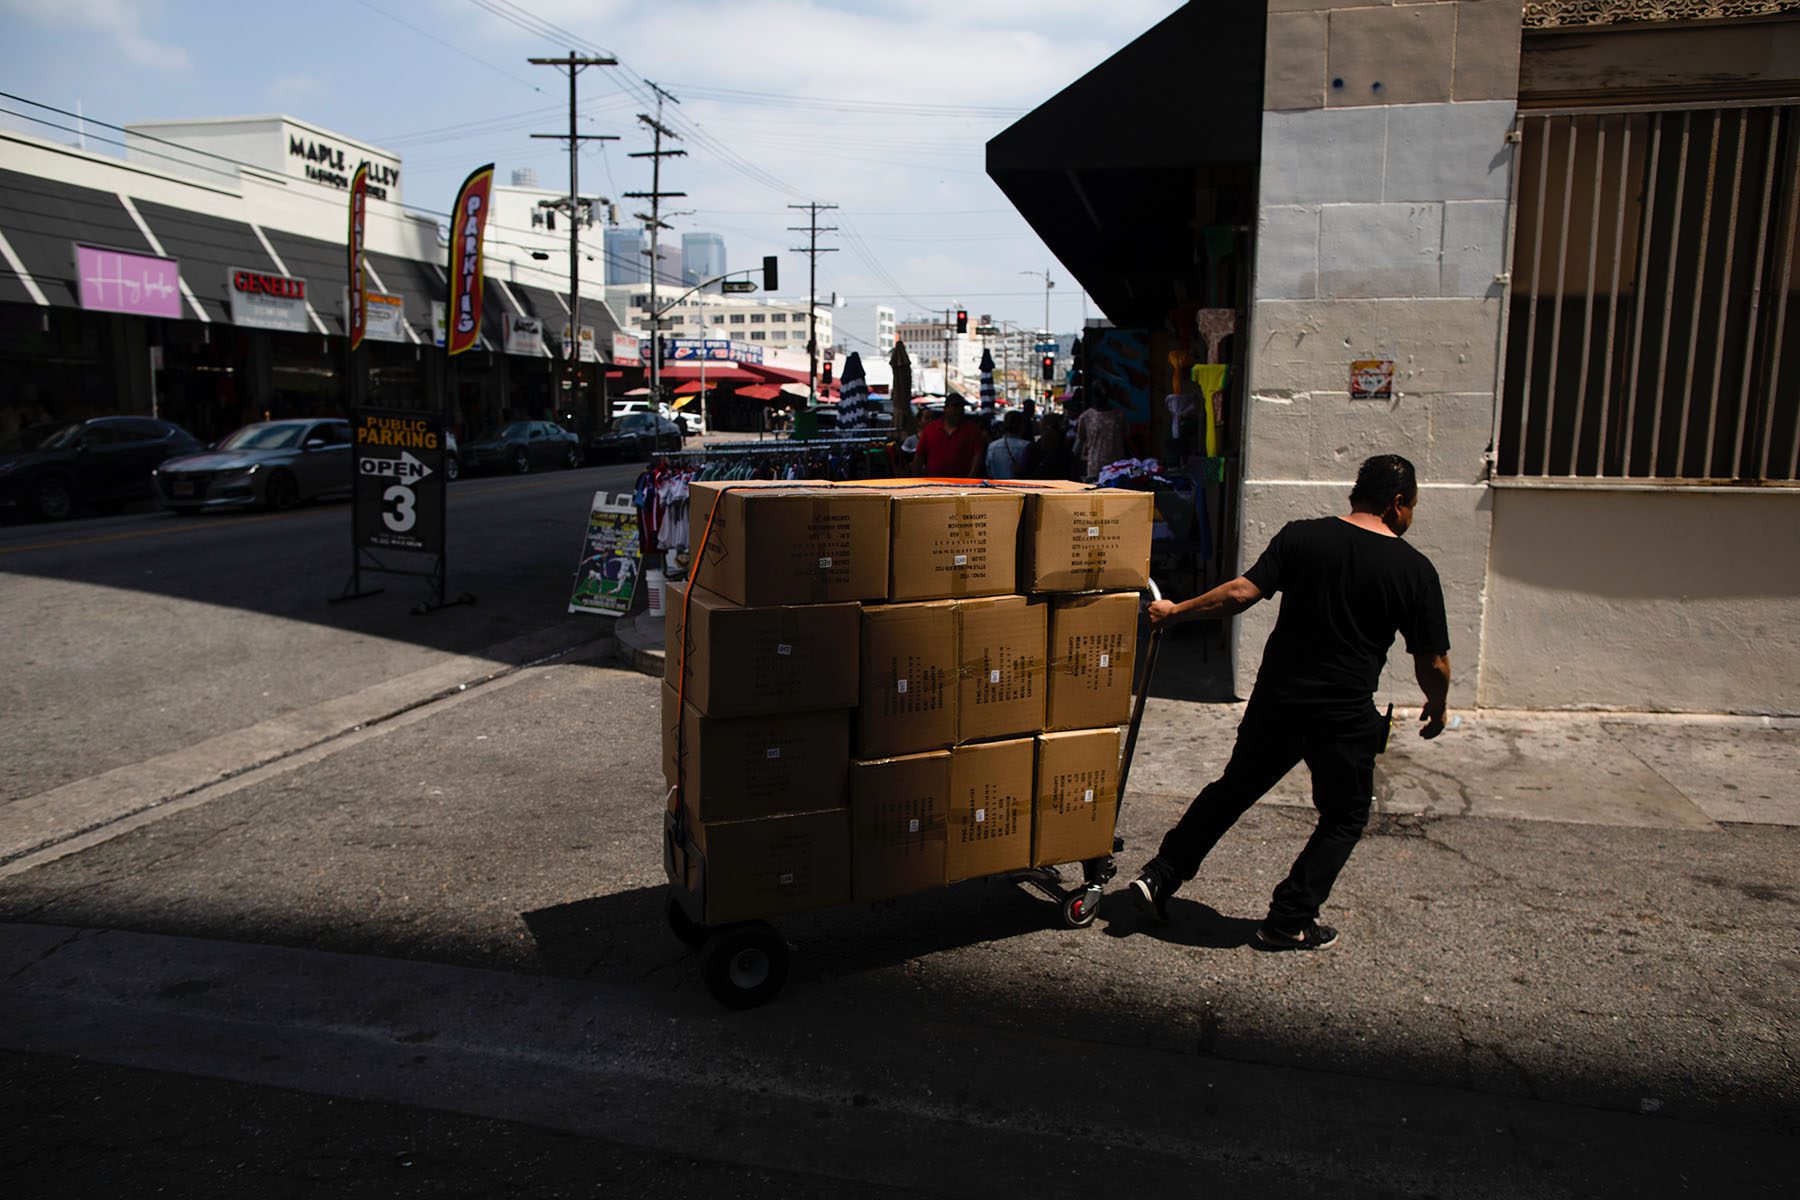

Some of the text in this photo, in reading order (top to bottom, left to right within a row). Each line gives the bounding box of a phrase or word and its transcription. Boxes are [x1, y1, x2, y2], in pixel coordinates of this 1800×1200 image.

[289, 133, 345, 171] MAPLE
[457, 194, 481, 333] PARKING
[234, 270, 305, 301] GENELLI
[358, 426, 437, 449] PARKING
[367, 416, 428, 432] PUBLIC
[361, 459, 424, 477] OPEN
[382, 485, 417, 532] 3
